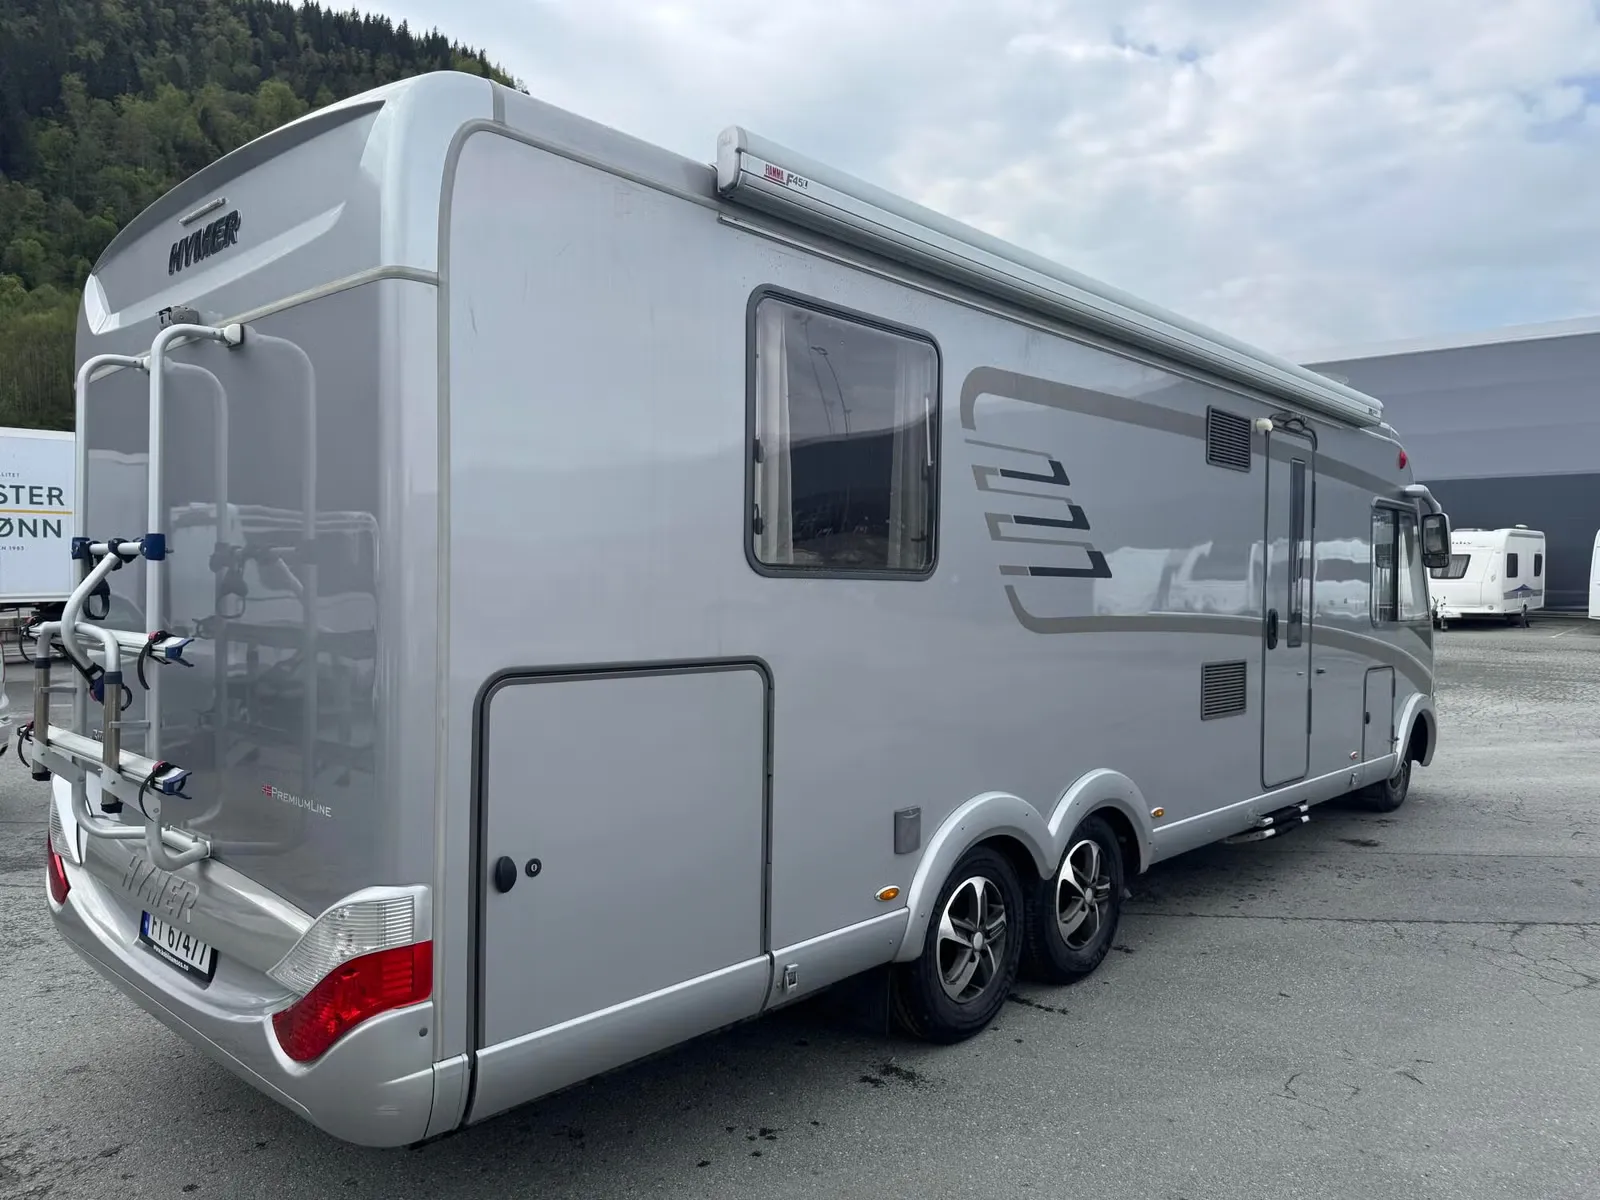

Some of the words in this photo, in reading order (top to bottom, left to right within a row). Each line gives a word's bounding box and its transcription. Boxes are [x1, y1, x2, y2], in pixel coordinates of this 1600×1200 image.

[168, 209, 242, 276] HYMER
[0, 517, 62, 538] ØNN
[122, 855, 199, 923] HYMER
